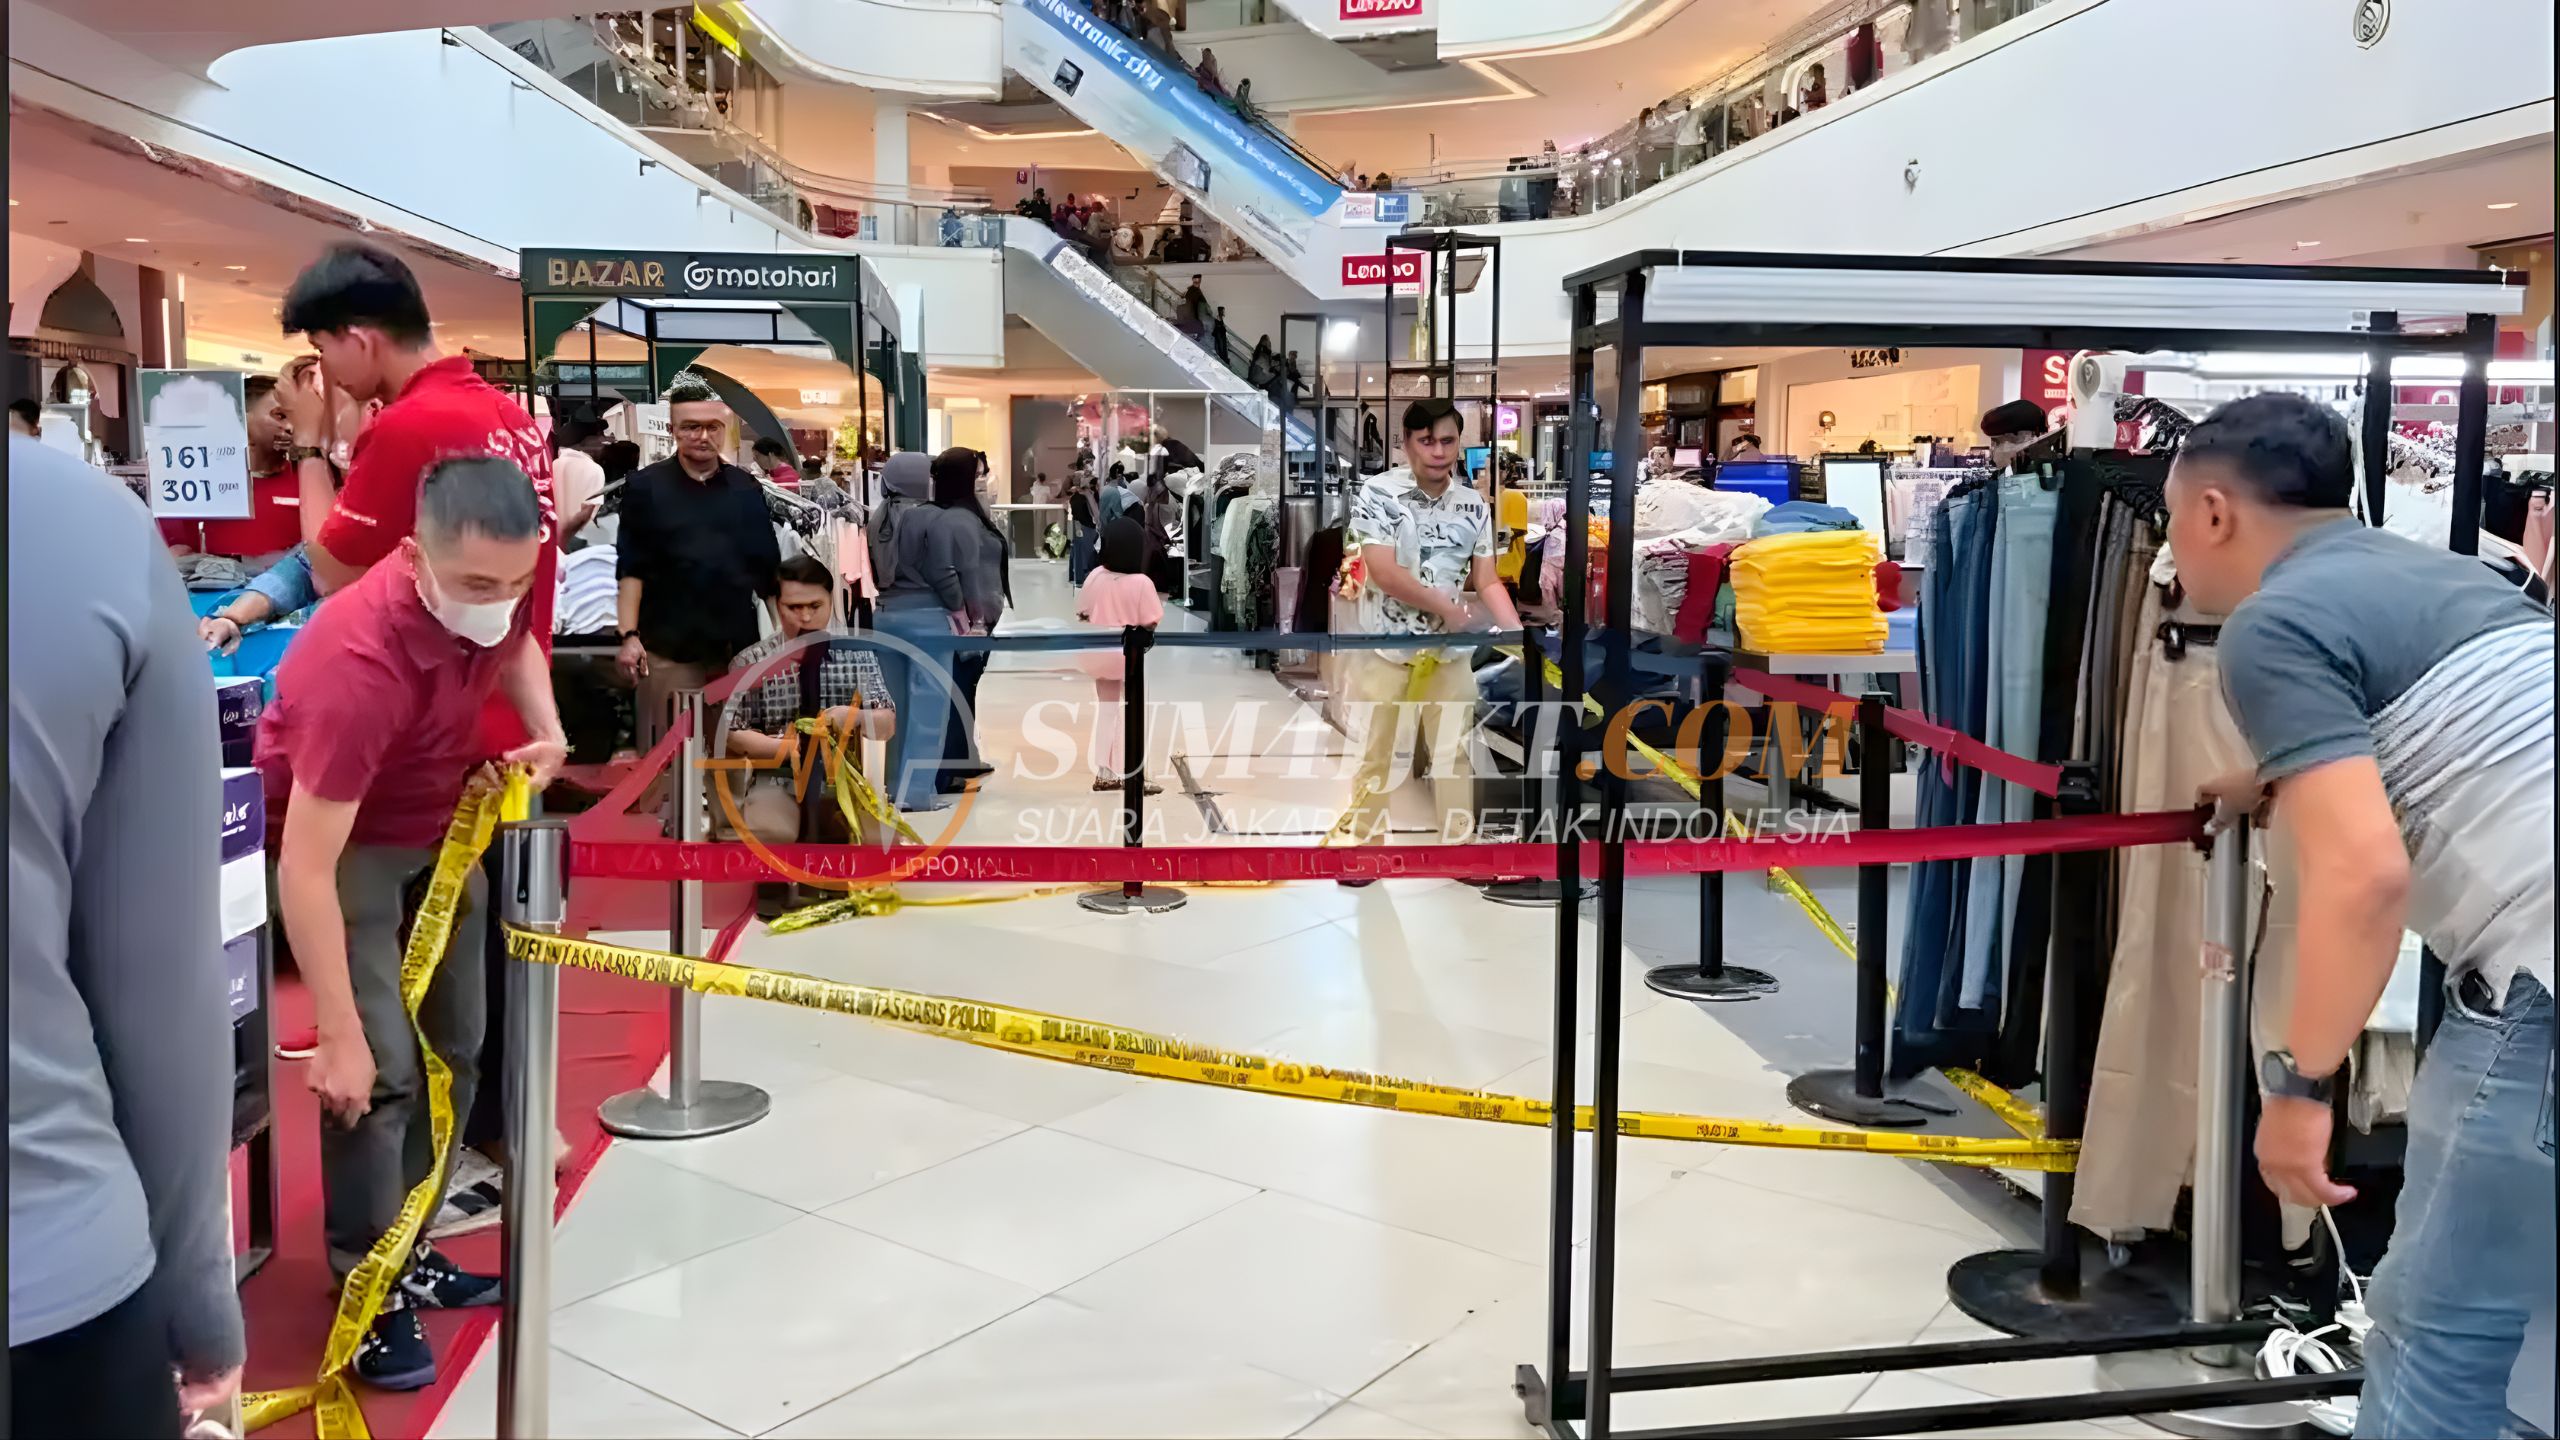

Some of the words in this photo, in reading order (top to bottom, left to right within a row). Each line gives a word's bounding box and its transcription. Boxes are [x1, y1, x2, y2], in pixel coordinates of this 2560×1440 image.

[548, 258, 665, 288] BAZAR
[161, 446, 209, 469] 161
[162, 479, 211, 502] 301
